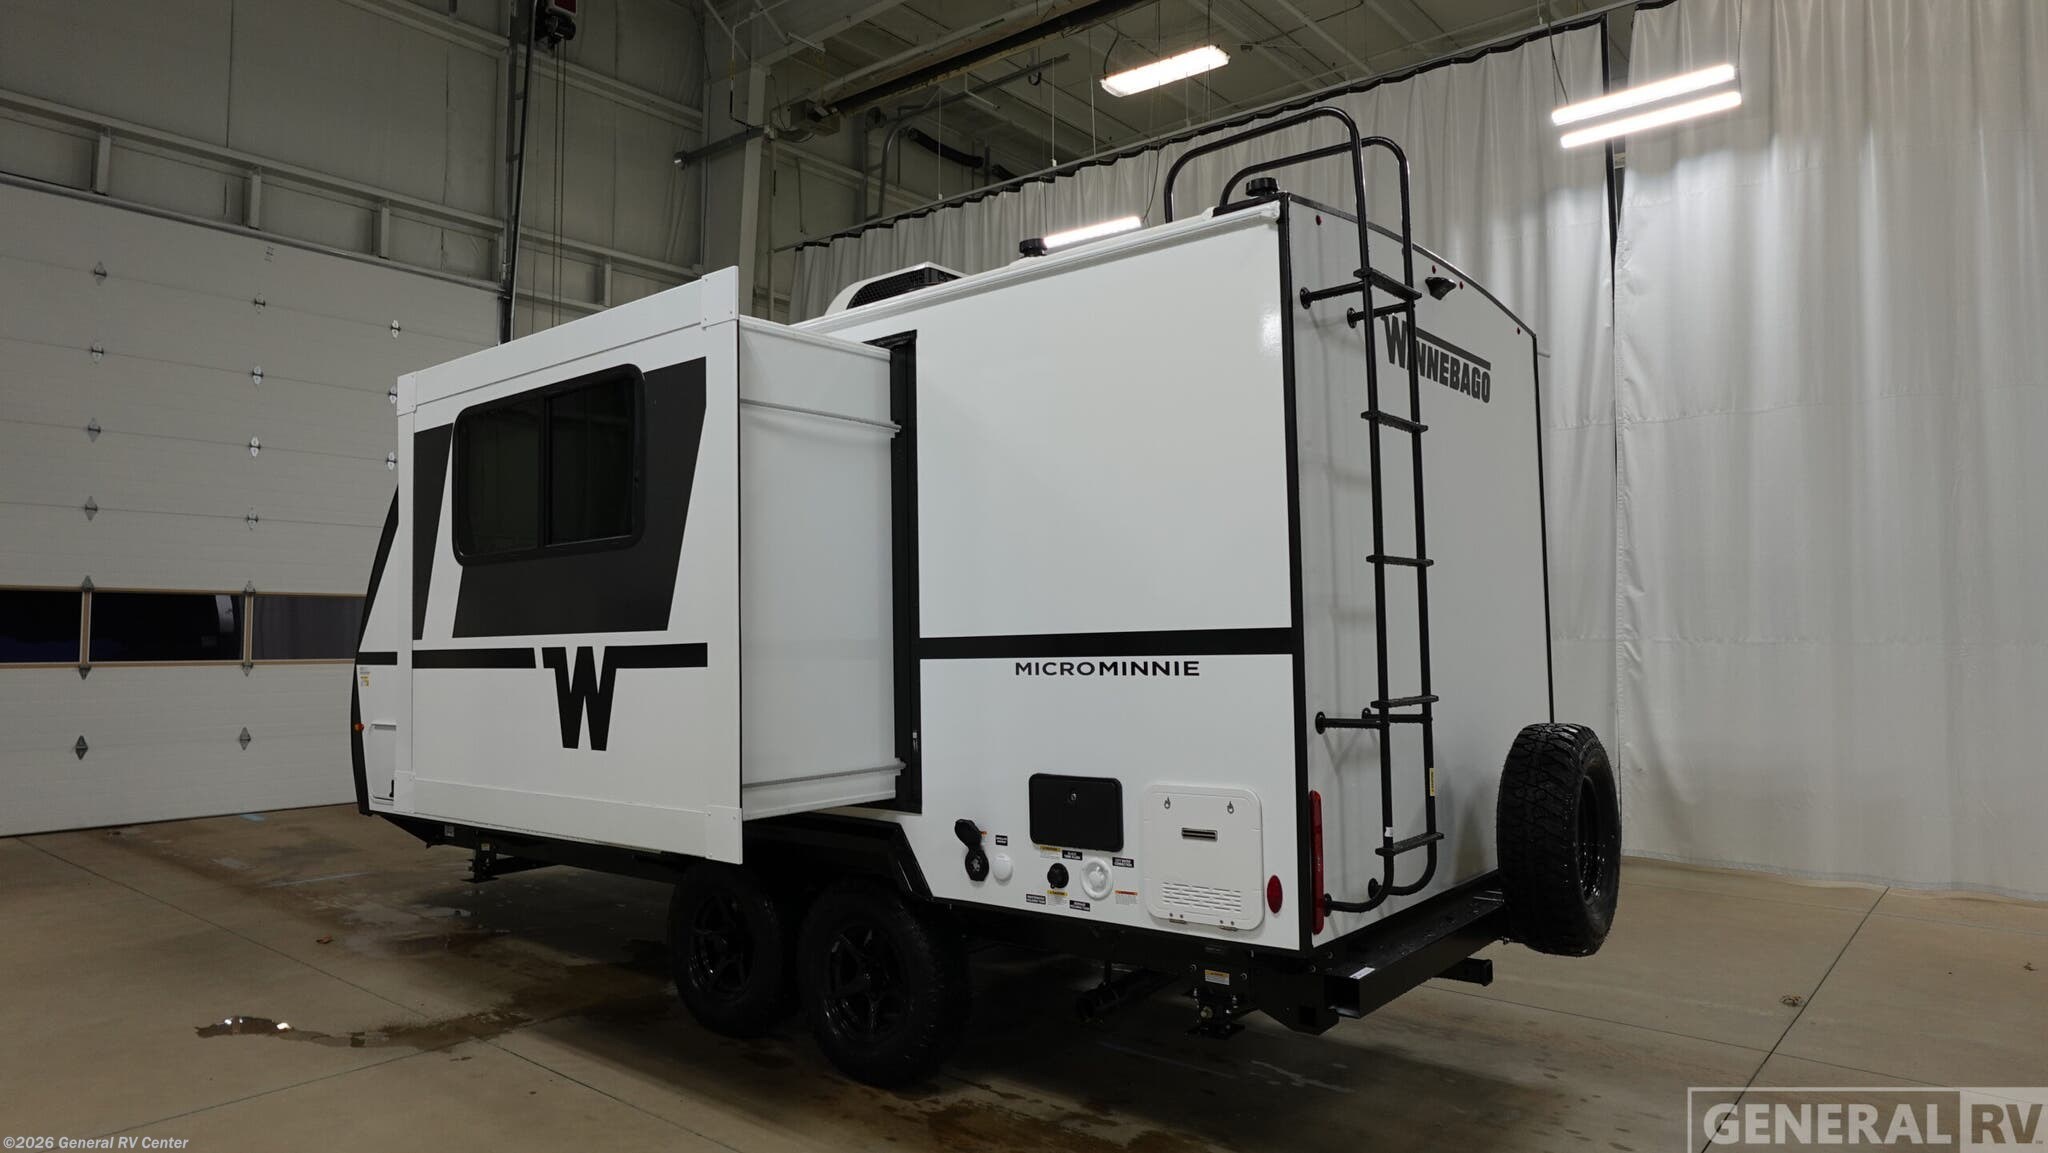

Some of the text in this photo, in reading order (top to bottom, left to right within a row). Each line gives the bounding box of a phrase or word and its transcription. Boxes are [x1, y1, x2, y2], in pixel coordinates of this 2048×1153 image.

[1381, 315, 1490, 403] WNNEBAGO
[542, 646, 617, 751] W
[1015, 661, 1200, 676] MICROMINNIE
